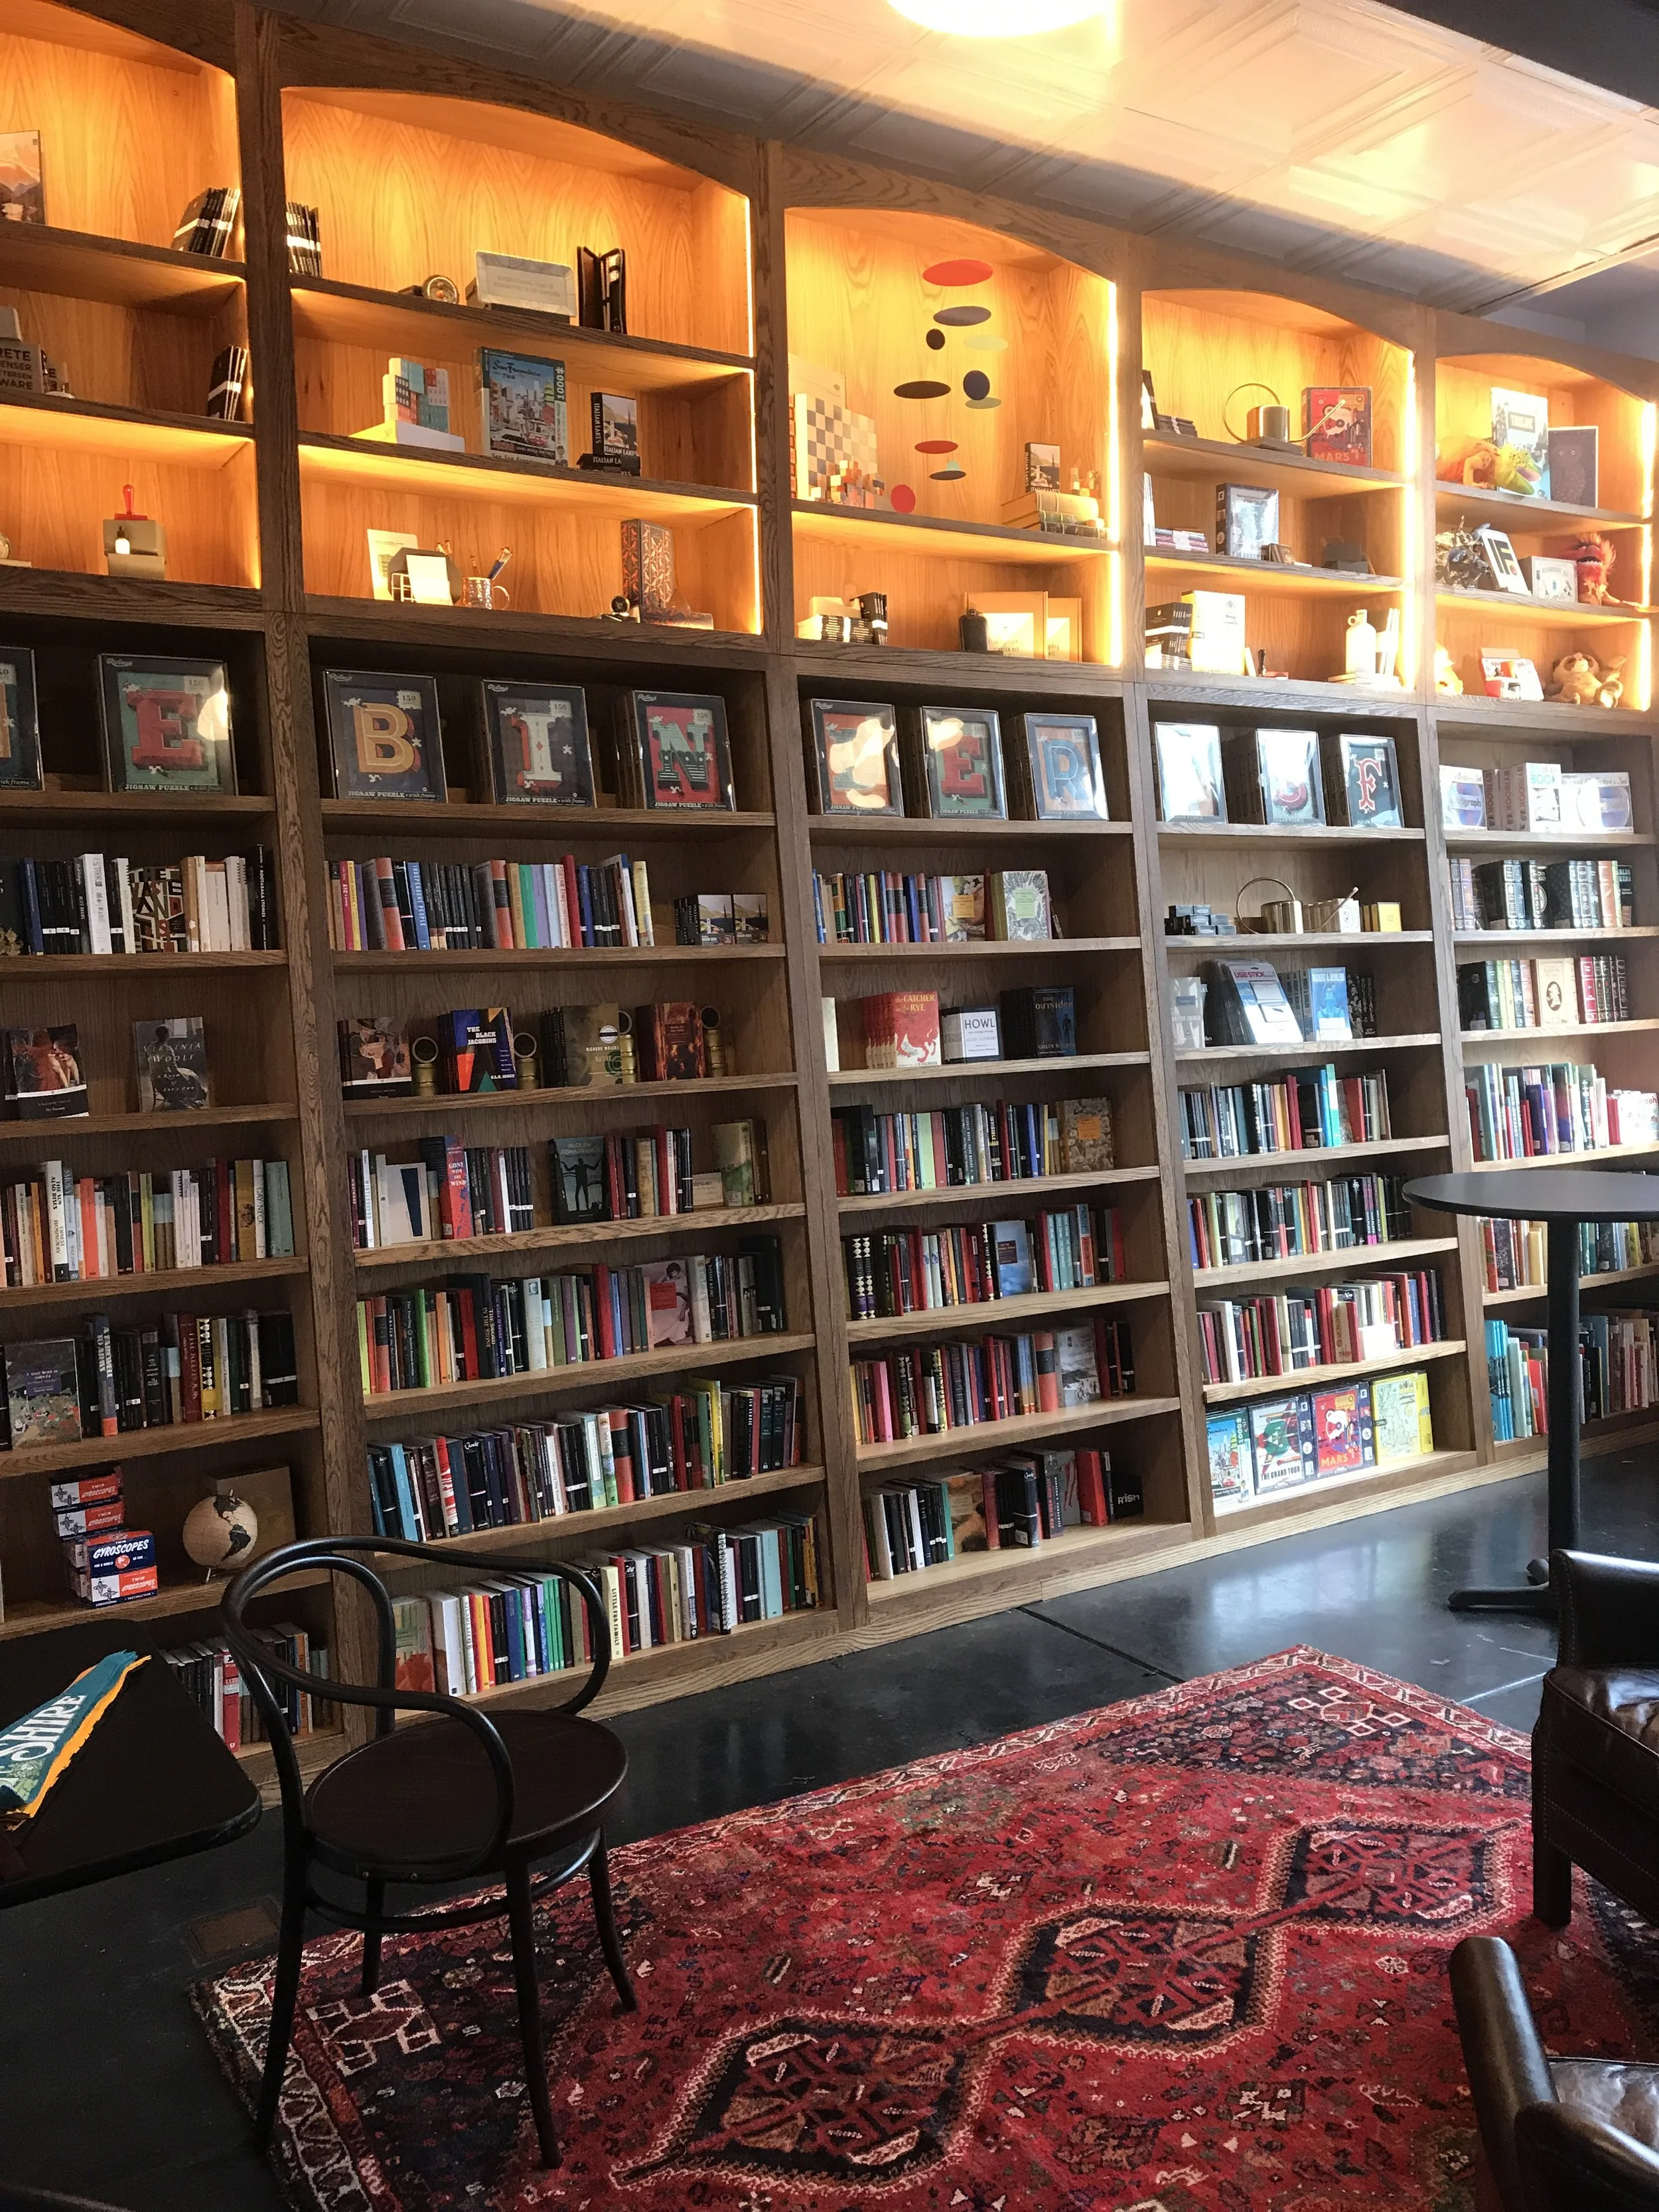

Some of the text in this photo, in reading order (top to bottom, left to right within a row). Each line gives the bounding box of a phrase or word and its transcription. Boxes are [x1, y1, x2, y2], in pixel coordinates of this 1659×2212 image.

[126, 688, 208, 771] E
[354, 702, 421, 774] B
[652, 721, 710, 791] N
[941, 734, 989, 798] E
[1044, 739, 1090, 800] R
[1355, 757, 1384, 813] F
[413, 865, 427, 926] INDEPENDENT PEOPLE
[904, 994, 936, 1002] CATCHER
[910, 1003, 926, 1012] RYE
[964, 1018, 996, 1029] HOWL
[143, 1042, 201, 1052] VIRGINIA
[153, 1054, 195, 1063] WOOLF
[1321, 1453, 1348, 1468] MARS
[1261, 1465, 1301, 1482] THE GRAND TOUR
[93, 1538, 150, 1560] GYROSCOPES
[121, 1578, 156, 1592] GYROSCOPES
